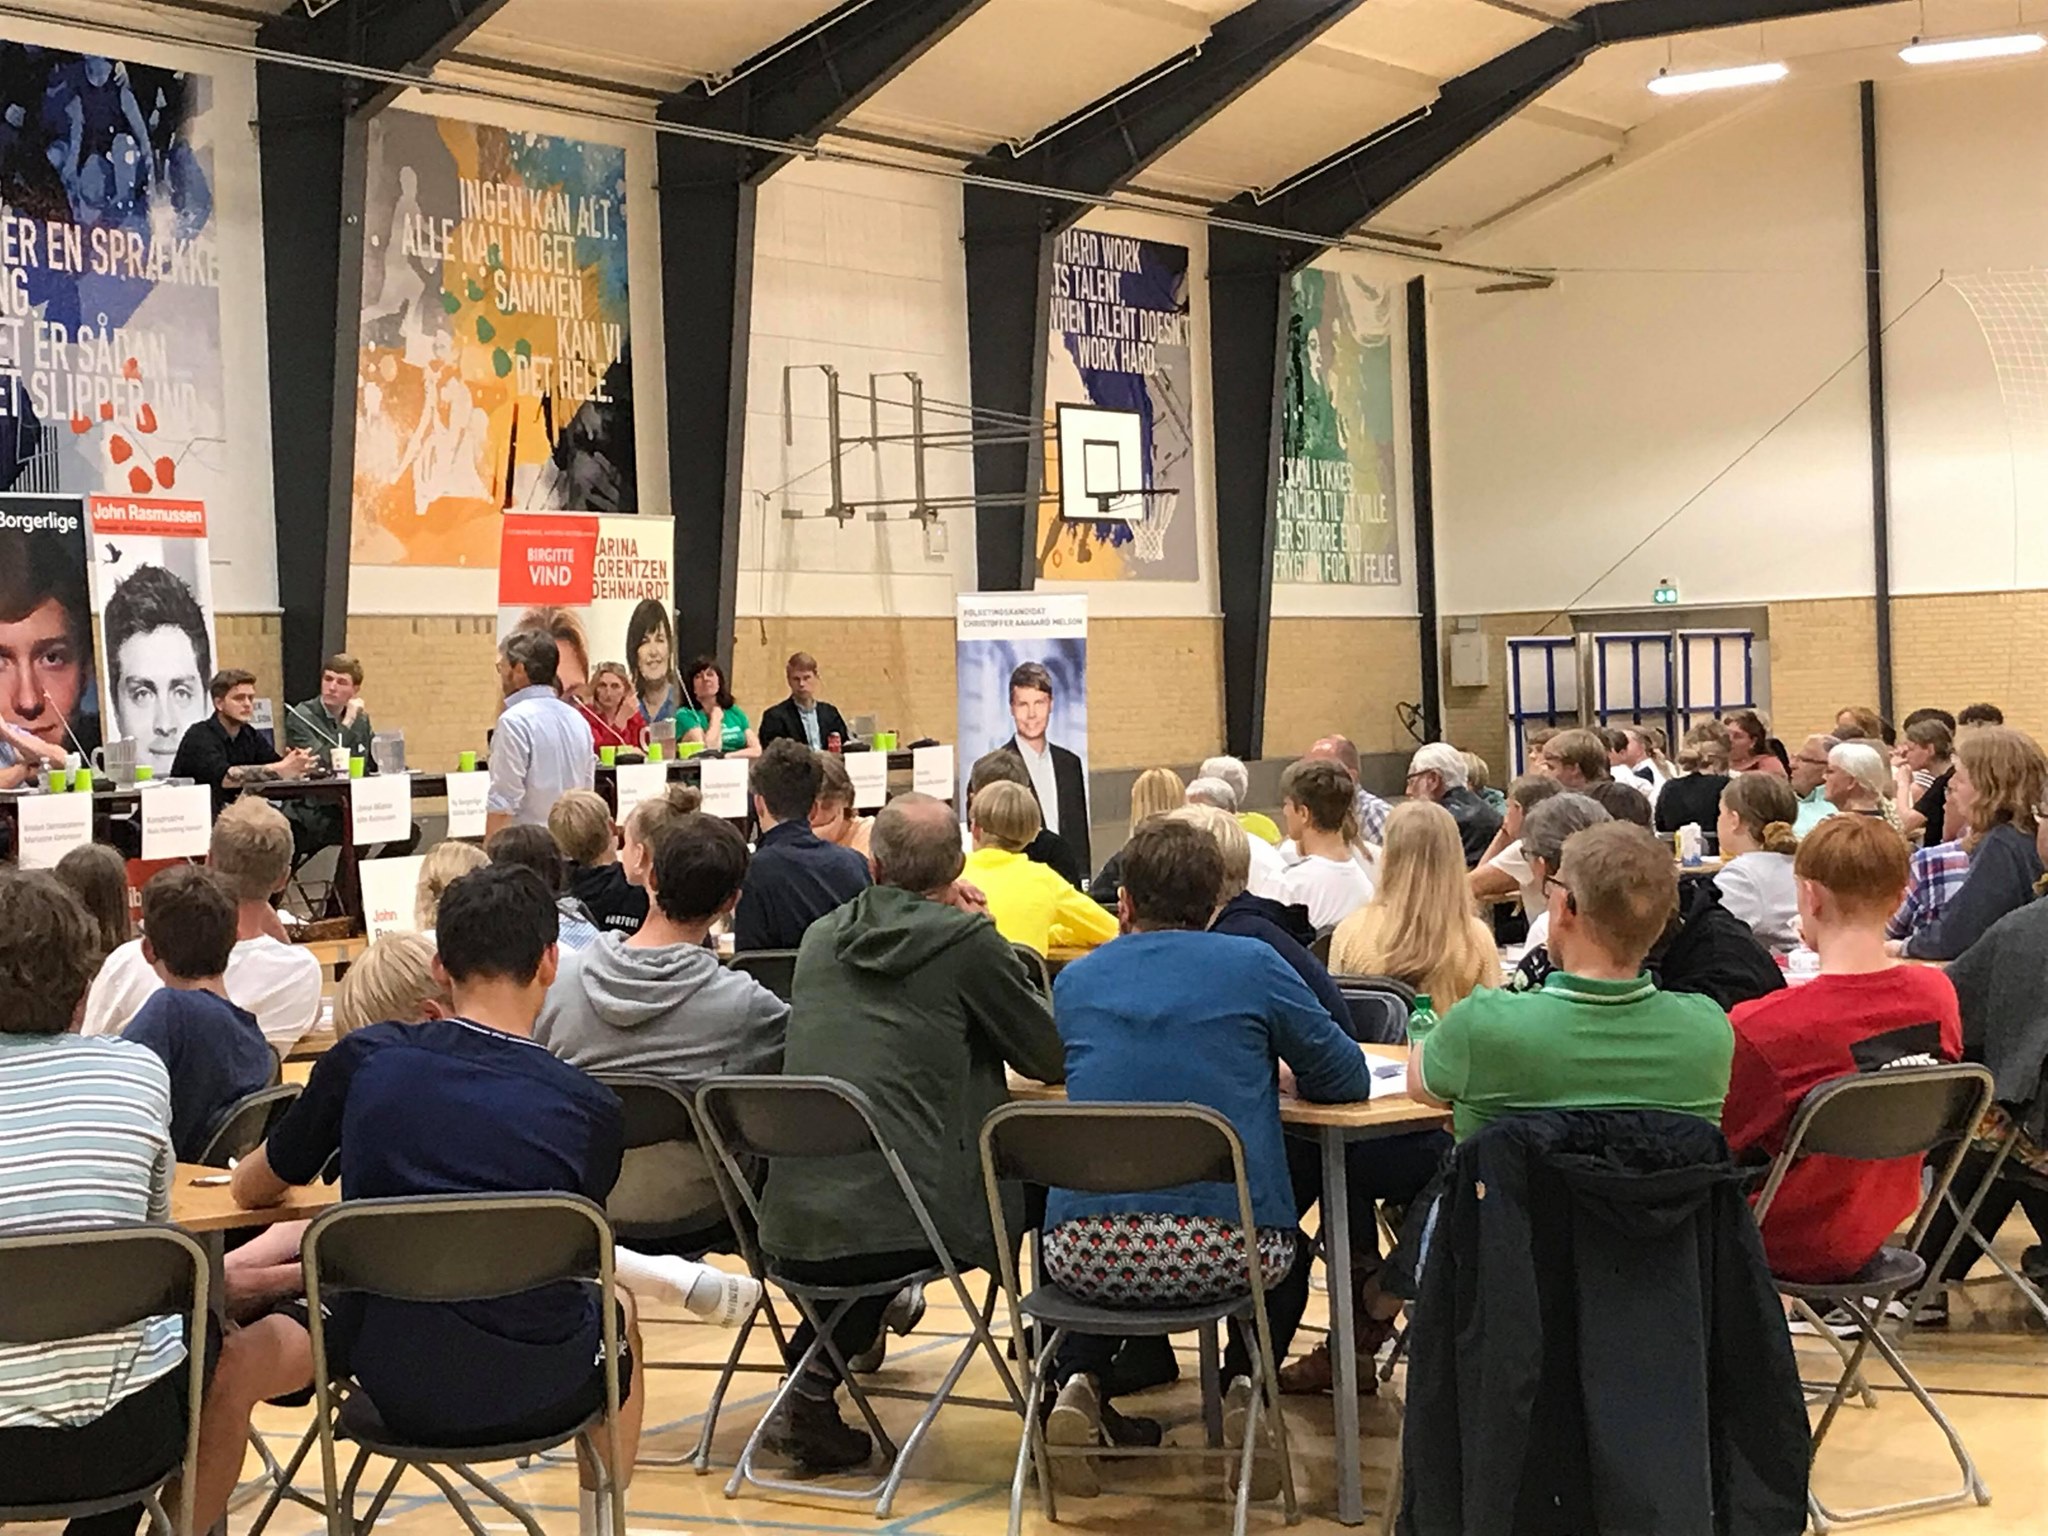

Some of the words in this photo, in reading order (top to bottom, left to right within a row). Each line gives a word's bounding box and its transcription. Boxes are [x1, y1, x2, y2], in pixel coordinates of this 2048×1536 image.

[459, 177, 526, 228] INGEN
[529, 188, 571, 235] KAN
[577, 196, 618, 241] ALT.
[1, 216, 39, 268] ER
[47, 221, 83, 273] EN
[91, 226, 219, 288] SPRÆKKE
[401, 213, 456, 262] ALLE
[461, 222, 504, 268] KAN
[511, 228, 581, 278] NOGET.
[1062, 230, 1098, 267] HARD
[1101, 235, 1142, 274] WORK
[0, 266, 38, 318] NG.
[494, 269, 583, 319] SAMMEN
[1051, 262, 1070, 297] TS
[557, 318, 597, 361] KAN
[602, 322, 622, 364] VI
[1088, 302, 1137, 340] TALENT
[0, 318, 24, 367] ET
[33, 320, 70, 371] ER
[77, 312, 168, 379] SÅDAN
[1078, 334, 1119, 372] WORK
[1121, 340, 1159, 376] HARD.
[31, 370, 148, 427] SLIPPER
[516, 354, 553, 398] DET
[559, 358, 614, 403] HELE.
[0, 512, 78, 534] Borgerlige
[94, 503, 126, 521] John
[129, 504, 201, 524] Rasmussen
[1323, 490, 1341, 521] TIL
[1344, 492, 1356, 523] AT
[1357, 493, 1388, 524] VILLE
[1278, 519, 1294, 550] ER
[527, 547, 574, 563] BIRGITTE
[1273, 550, 1322, 582] FRYGTN
[1324, 552, 1347, 583] FOR
[1348, 553, 1361, 583] AT
[529, 565, 572, 586] VIND
[592, 580, 669, 600] DEHNHARDT
[373, 909, 398, 922] John
